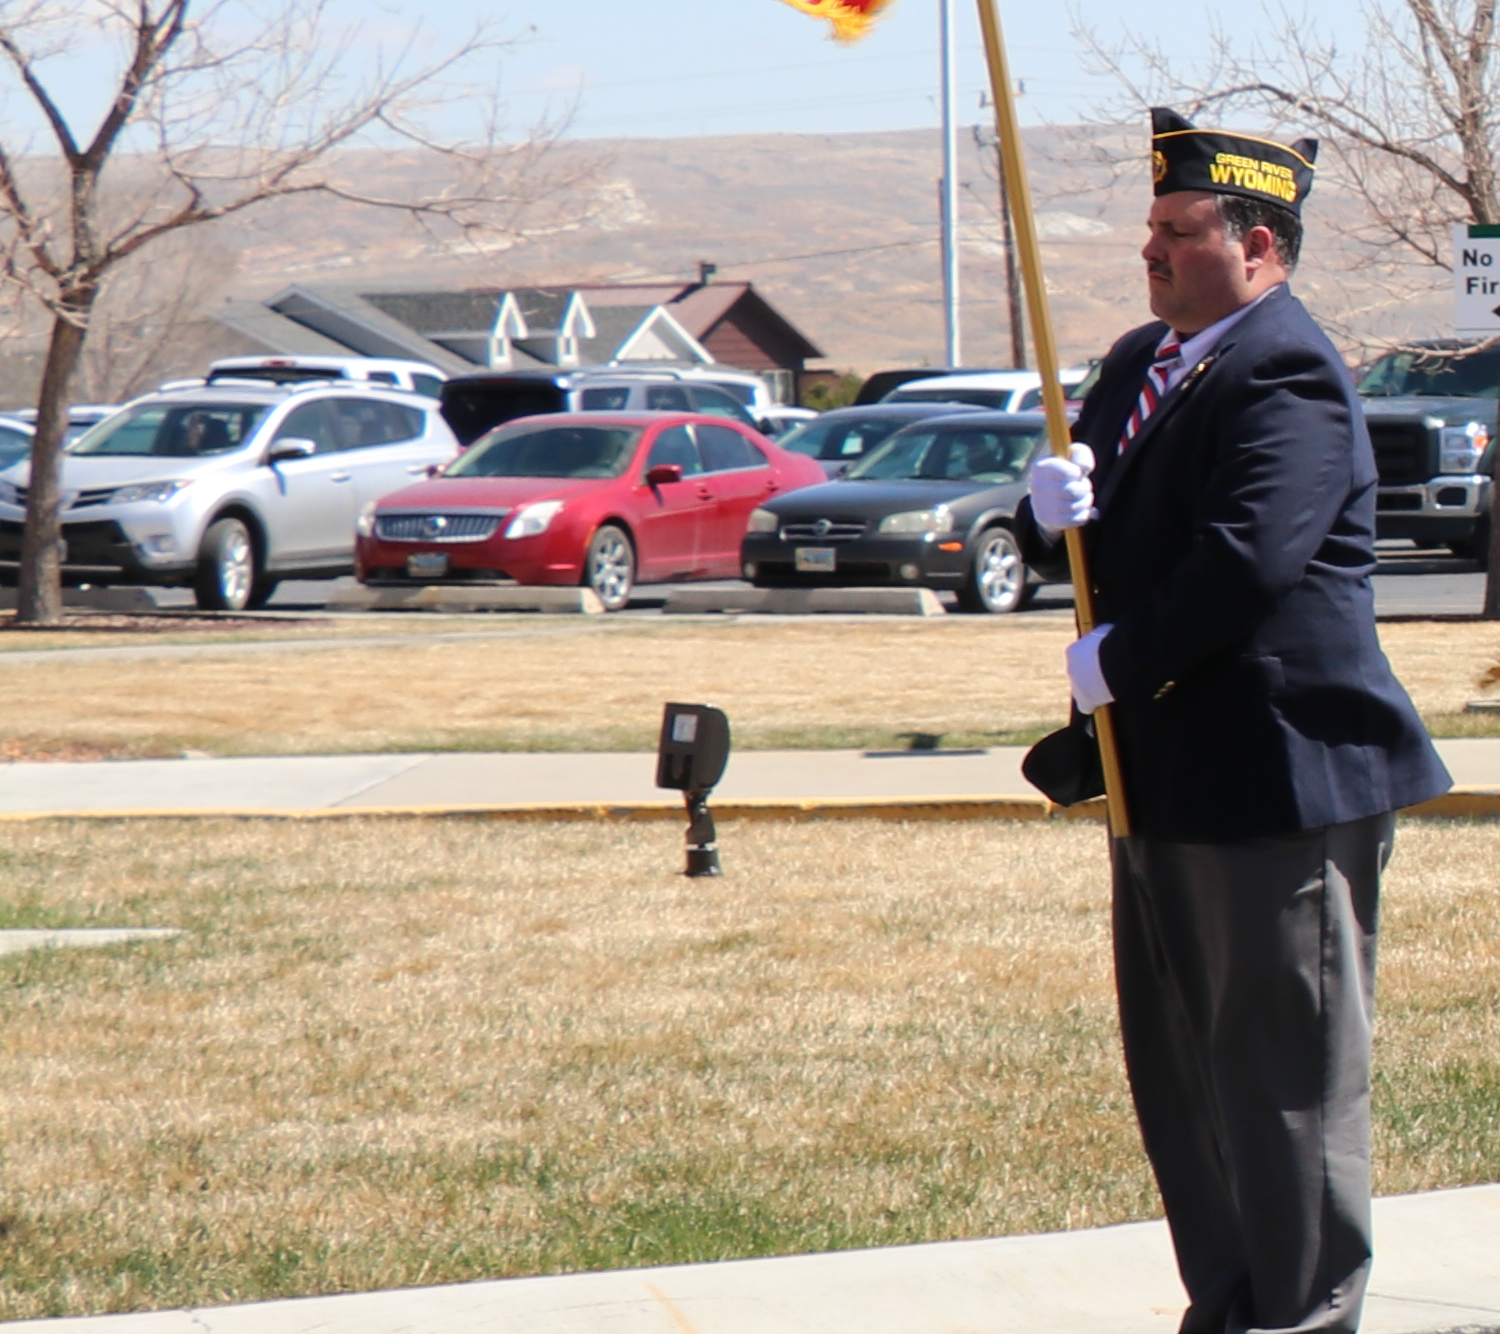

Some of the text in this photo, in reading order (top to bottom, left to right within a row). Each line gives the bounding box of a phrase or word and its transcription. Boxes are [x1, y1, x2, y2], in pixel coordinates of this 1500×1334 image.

[1215, 152, 1294, 181] GREEN RIVER
[1209, 164, 1298, 203] WYOMING
[1462, 249, 1493, 267] No
